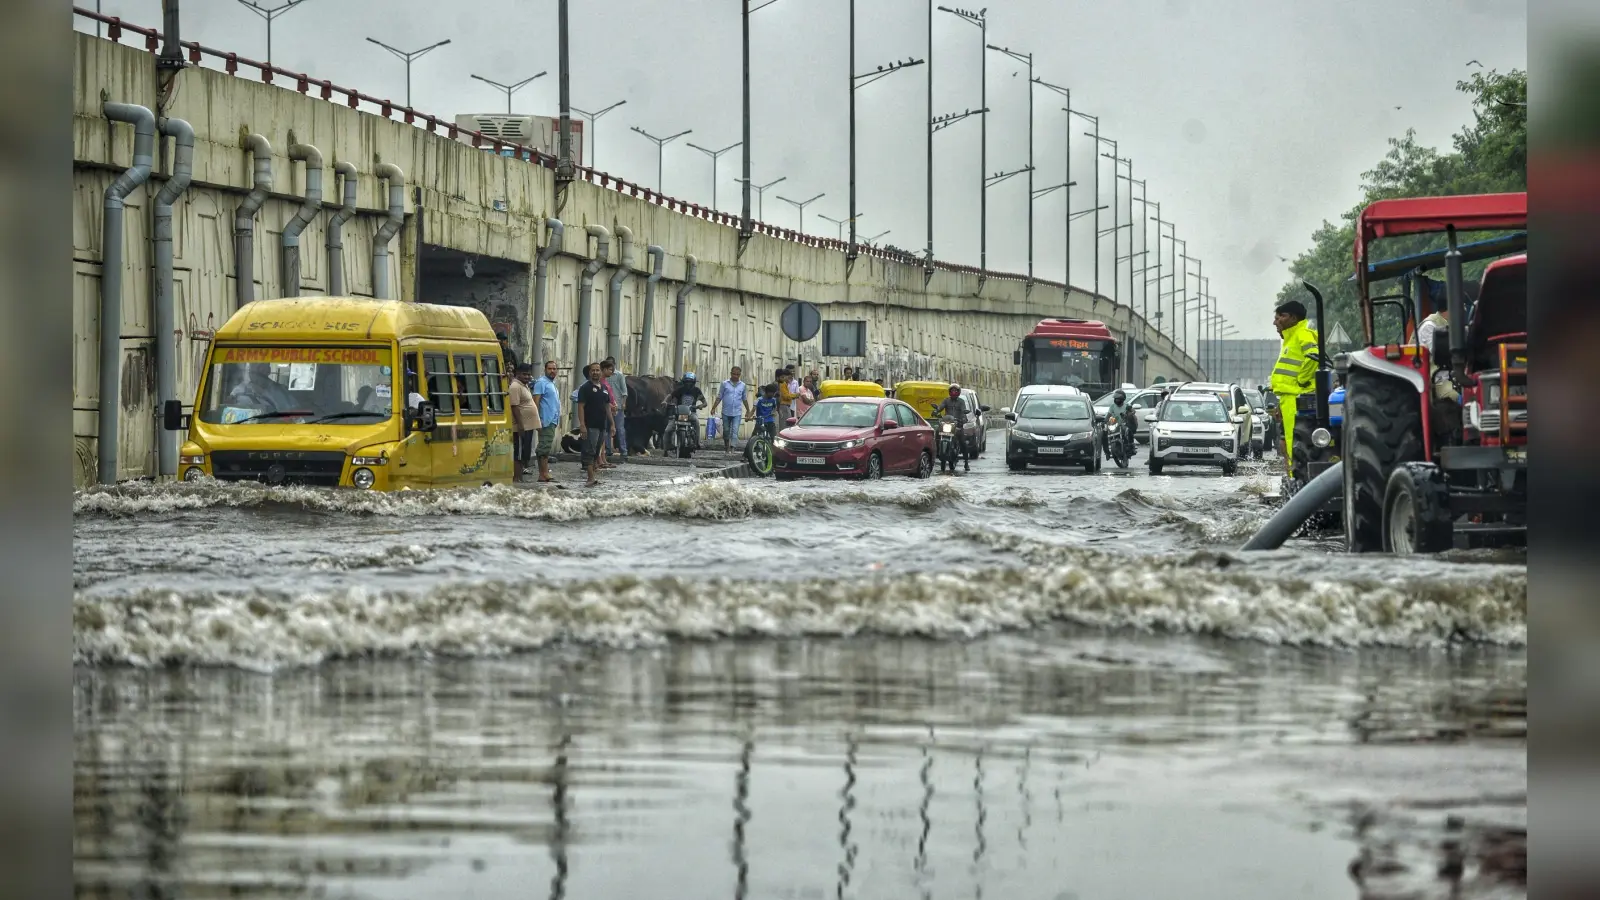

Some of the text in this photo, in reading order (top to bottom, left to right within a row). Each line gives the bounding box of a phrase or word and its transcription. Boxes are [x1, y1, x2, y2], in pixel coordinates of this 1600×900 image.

[225, 349, 380, 362] ARMY PUBLIC SCHOOL
